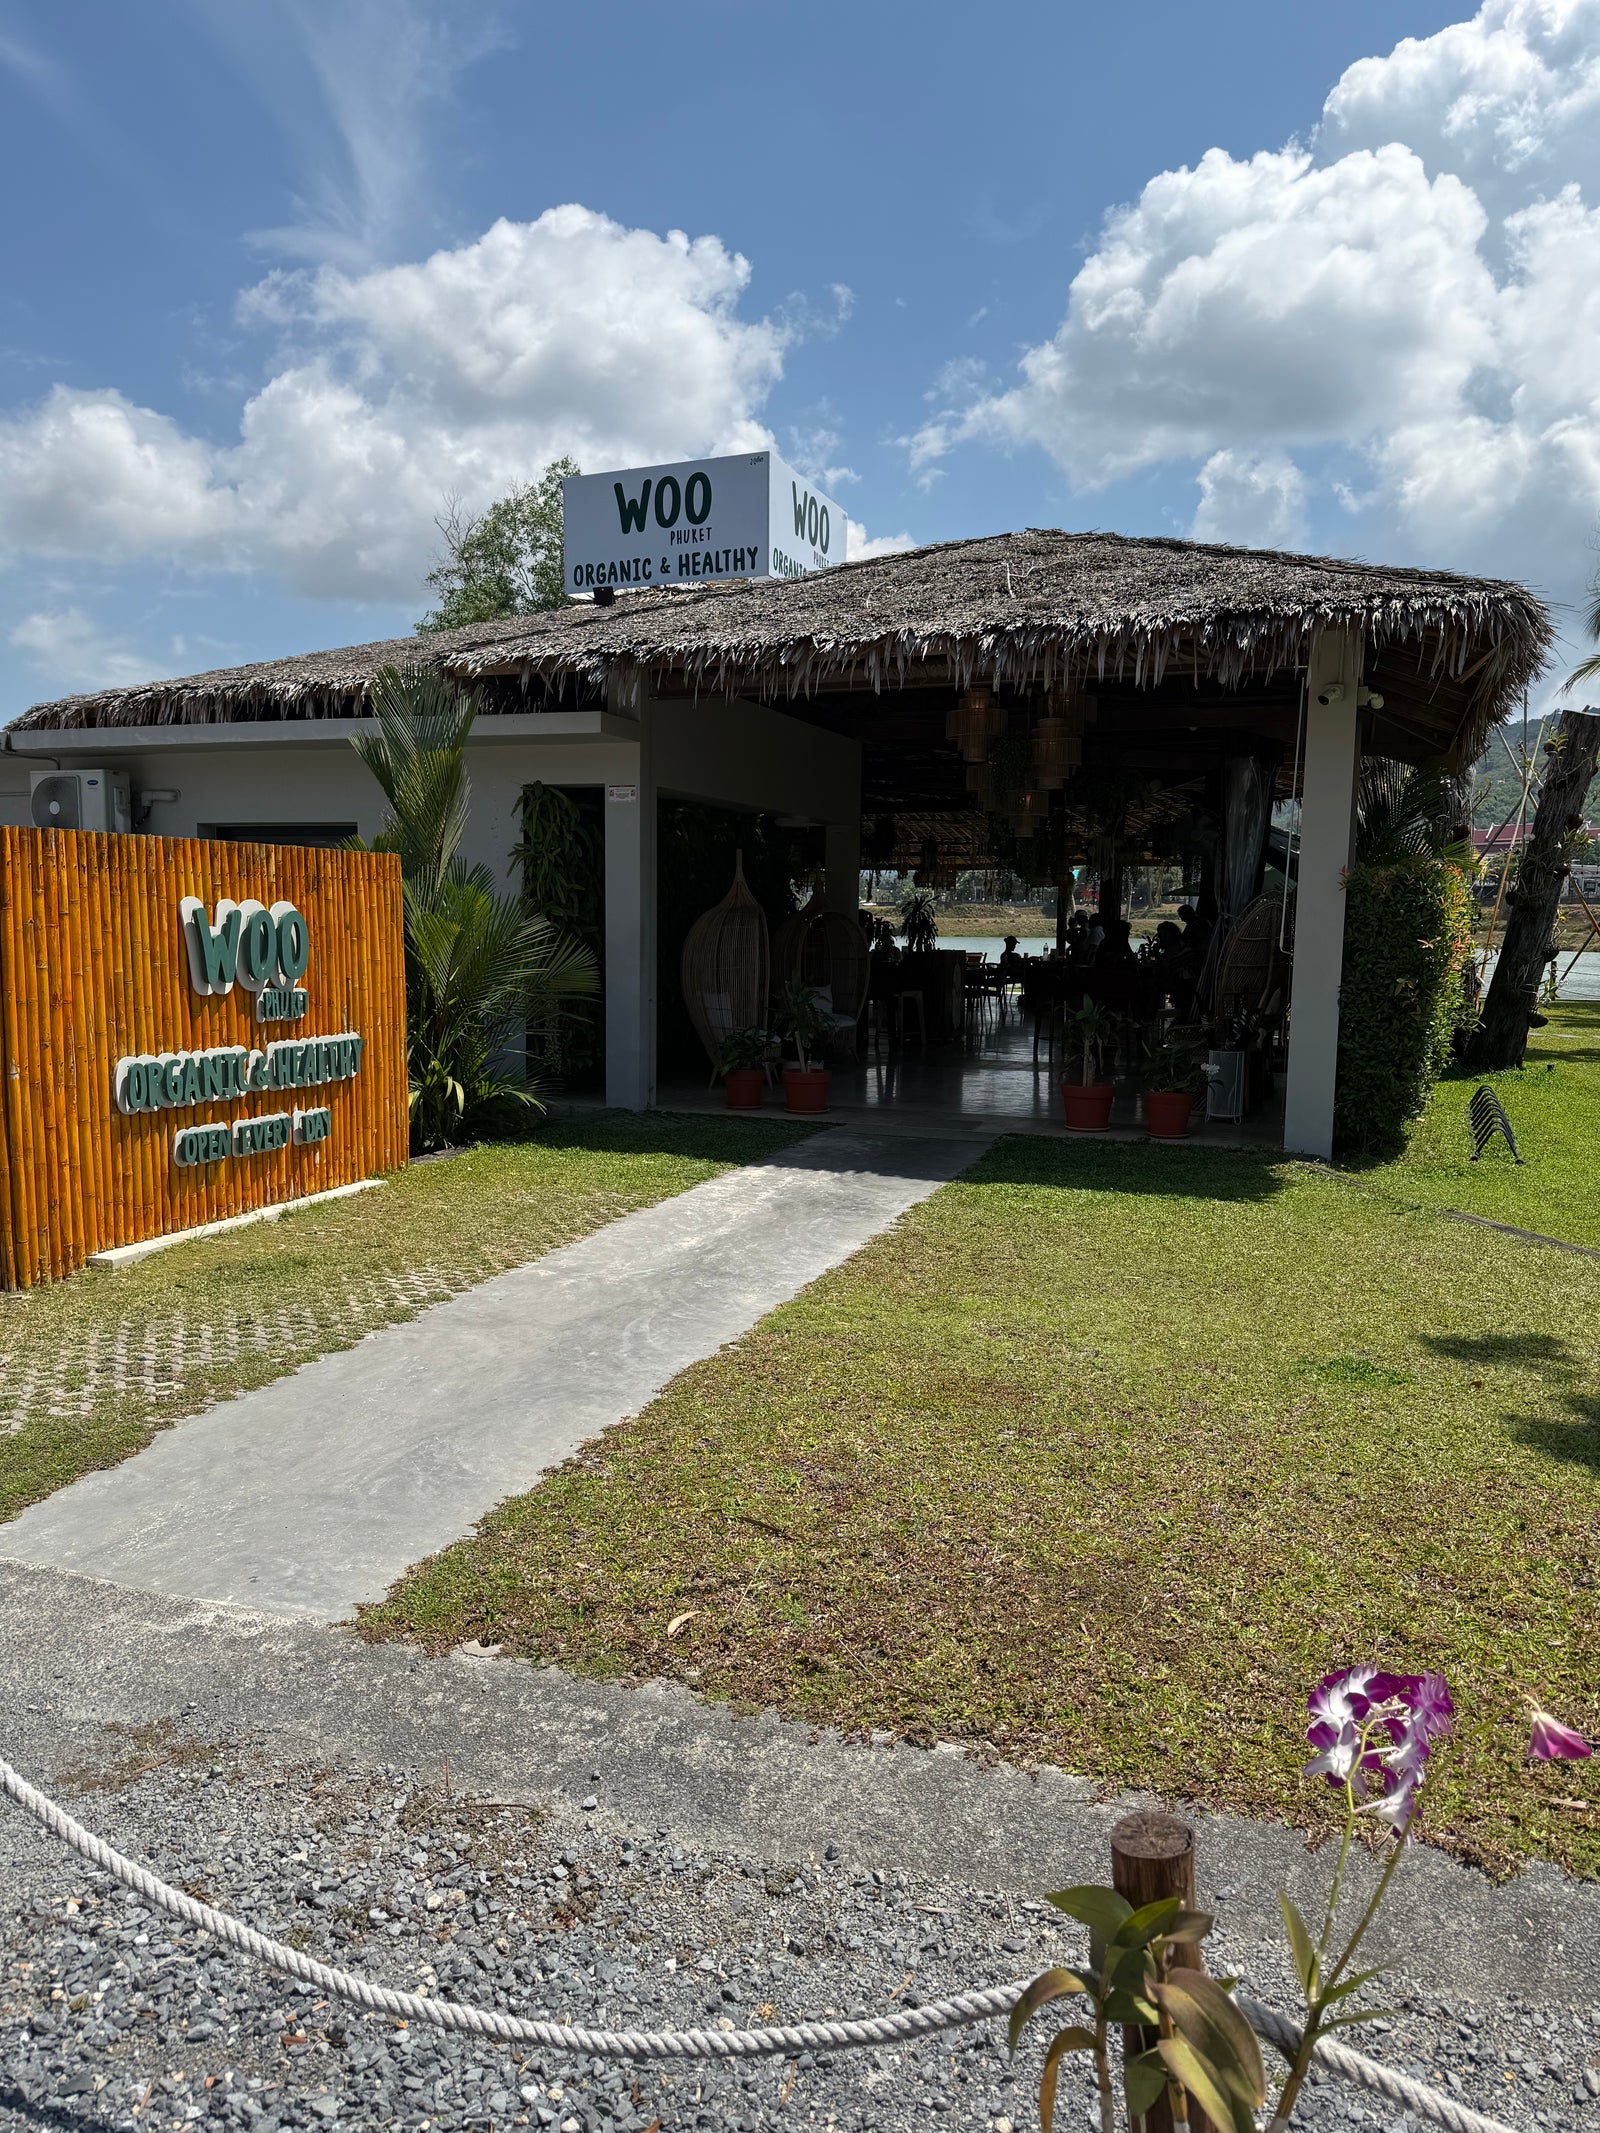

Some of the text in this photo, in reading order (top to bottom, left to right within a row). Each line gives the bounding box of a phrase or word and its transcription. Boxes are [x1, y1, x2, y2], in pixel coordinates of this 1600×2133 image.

[614, 471, 712, 535] WOO
[792, 480, 830, 555] WOO
[573, 546, 759, 587] ORGANIC & HEALTHY
[670, 527, 713, 546] PHUKET
[189, 903, 310, 987] WOO
[261, 988, 310, 1021] PHUKET
[125, 1036, 363, 1110] ORGANIC & HEALTHY
[181, 1109, 332, 1165] OPEN EVERY DAY
